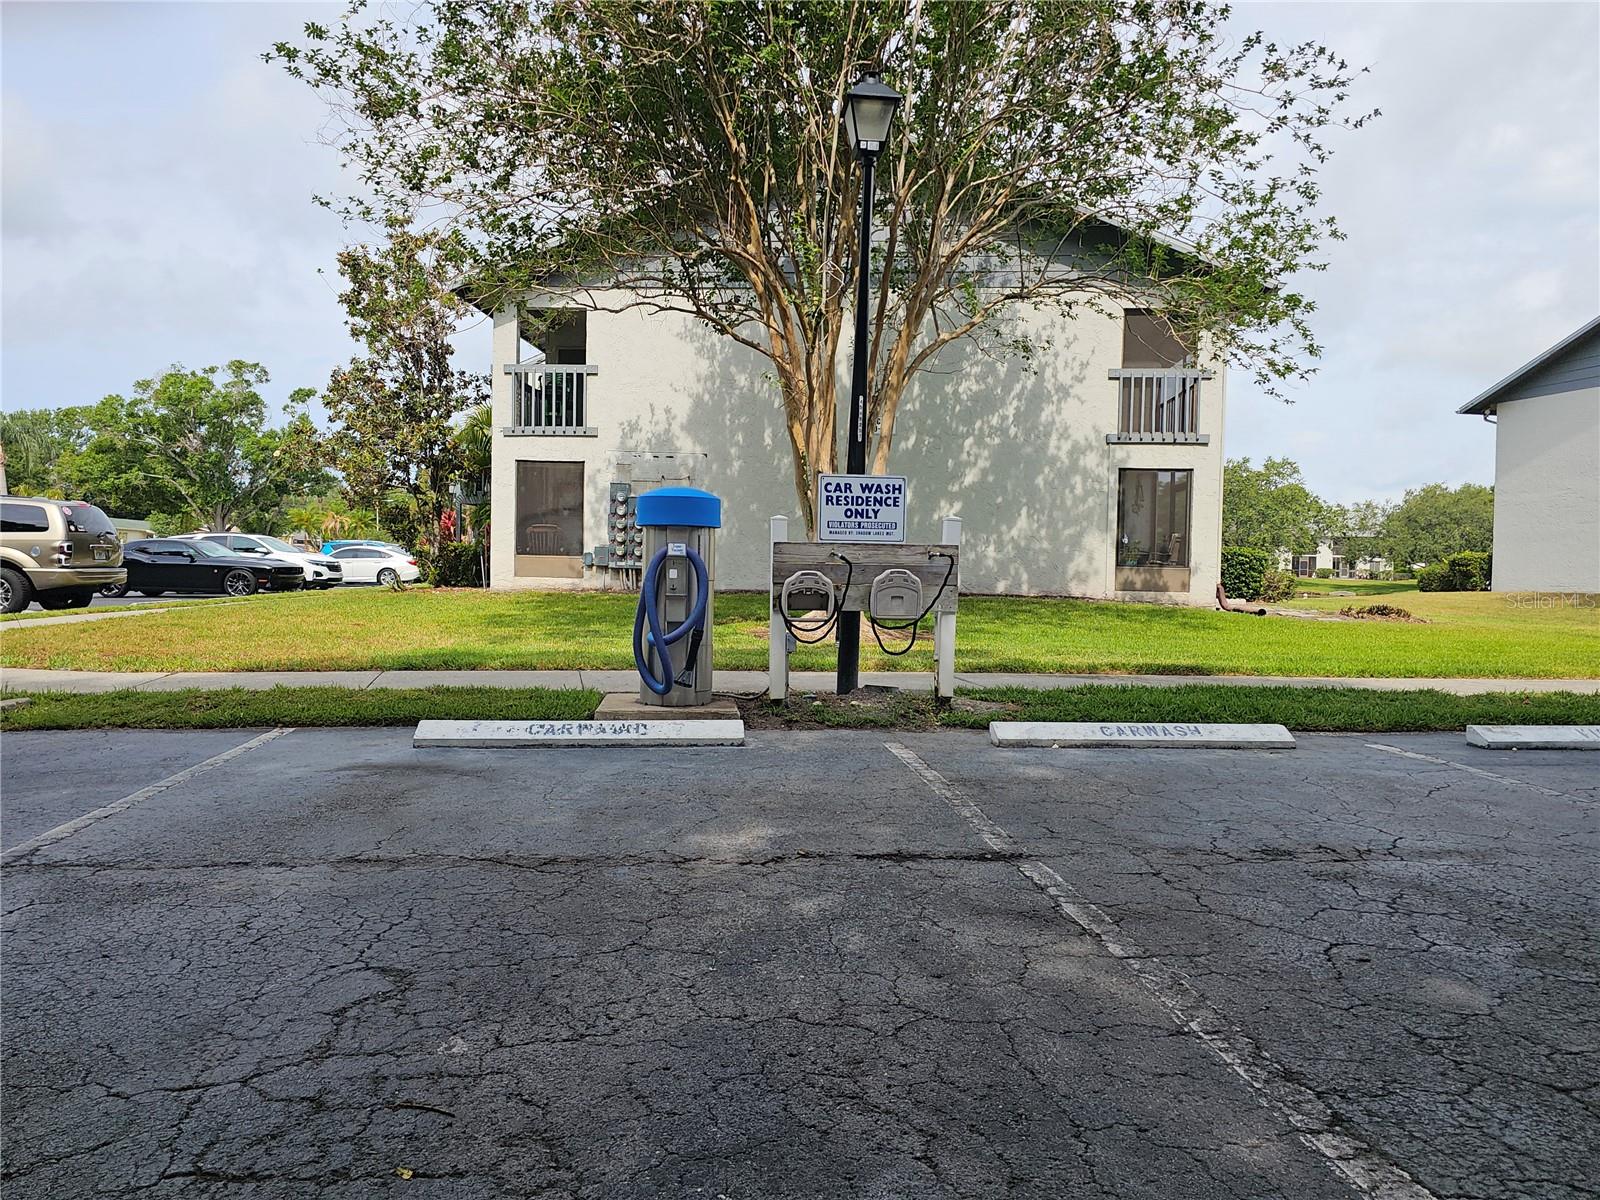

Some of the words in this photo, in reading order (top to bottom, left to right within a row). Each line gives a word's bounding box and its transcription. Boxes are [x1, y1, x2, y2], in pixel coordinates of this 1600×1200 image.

[824, 482, 852, 493] CAR
[860, 483, 902, 494] WASH
[826, 495, 900, 507] RESIDENCE
[844, 508, 880, 519] ONLY
[1100, 726, 1202, 736] CARWASH
